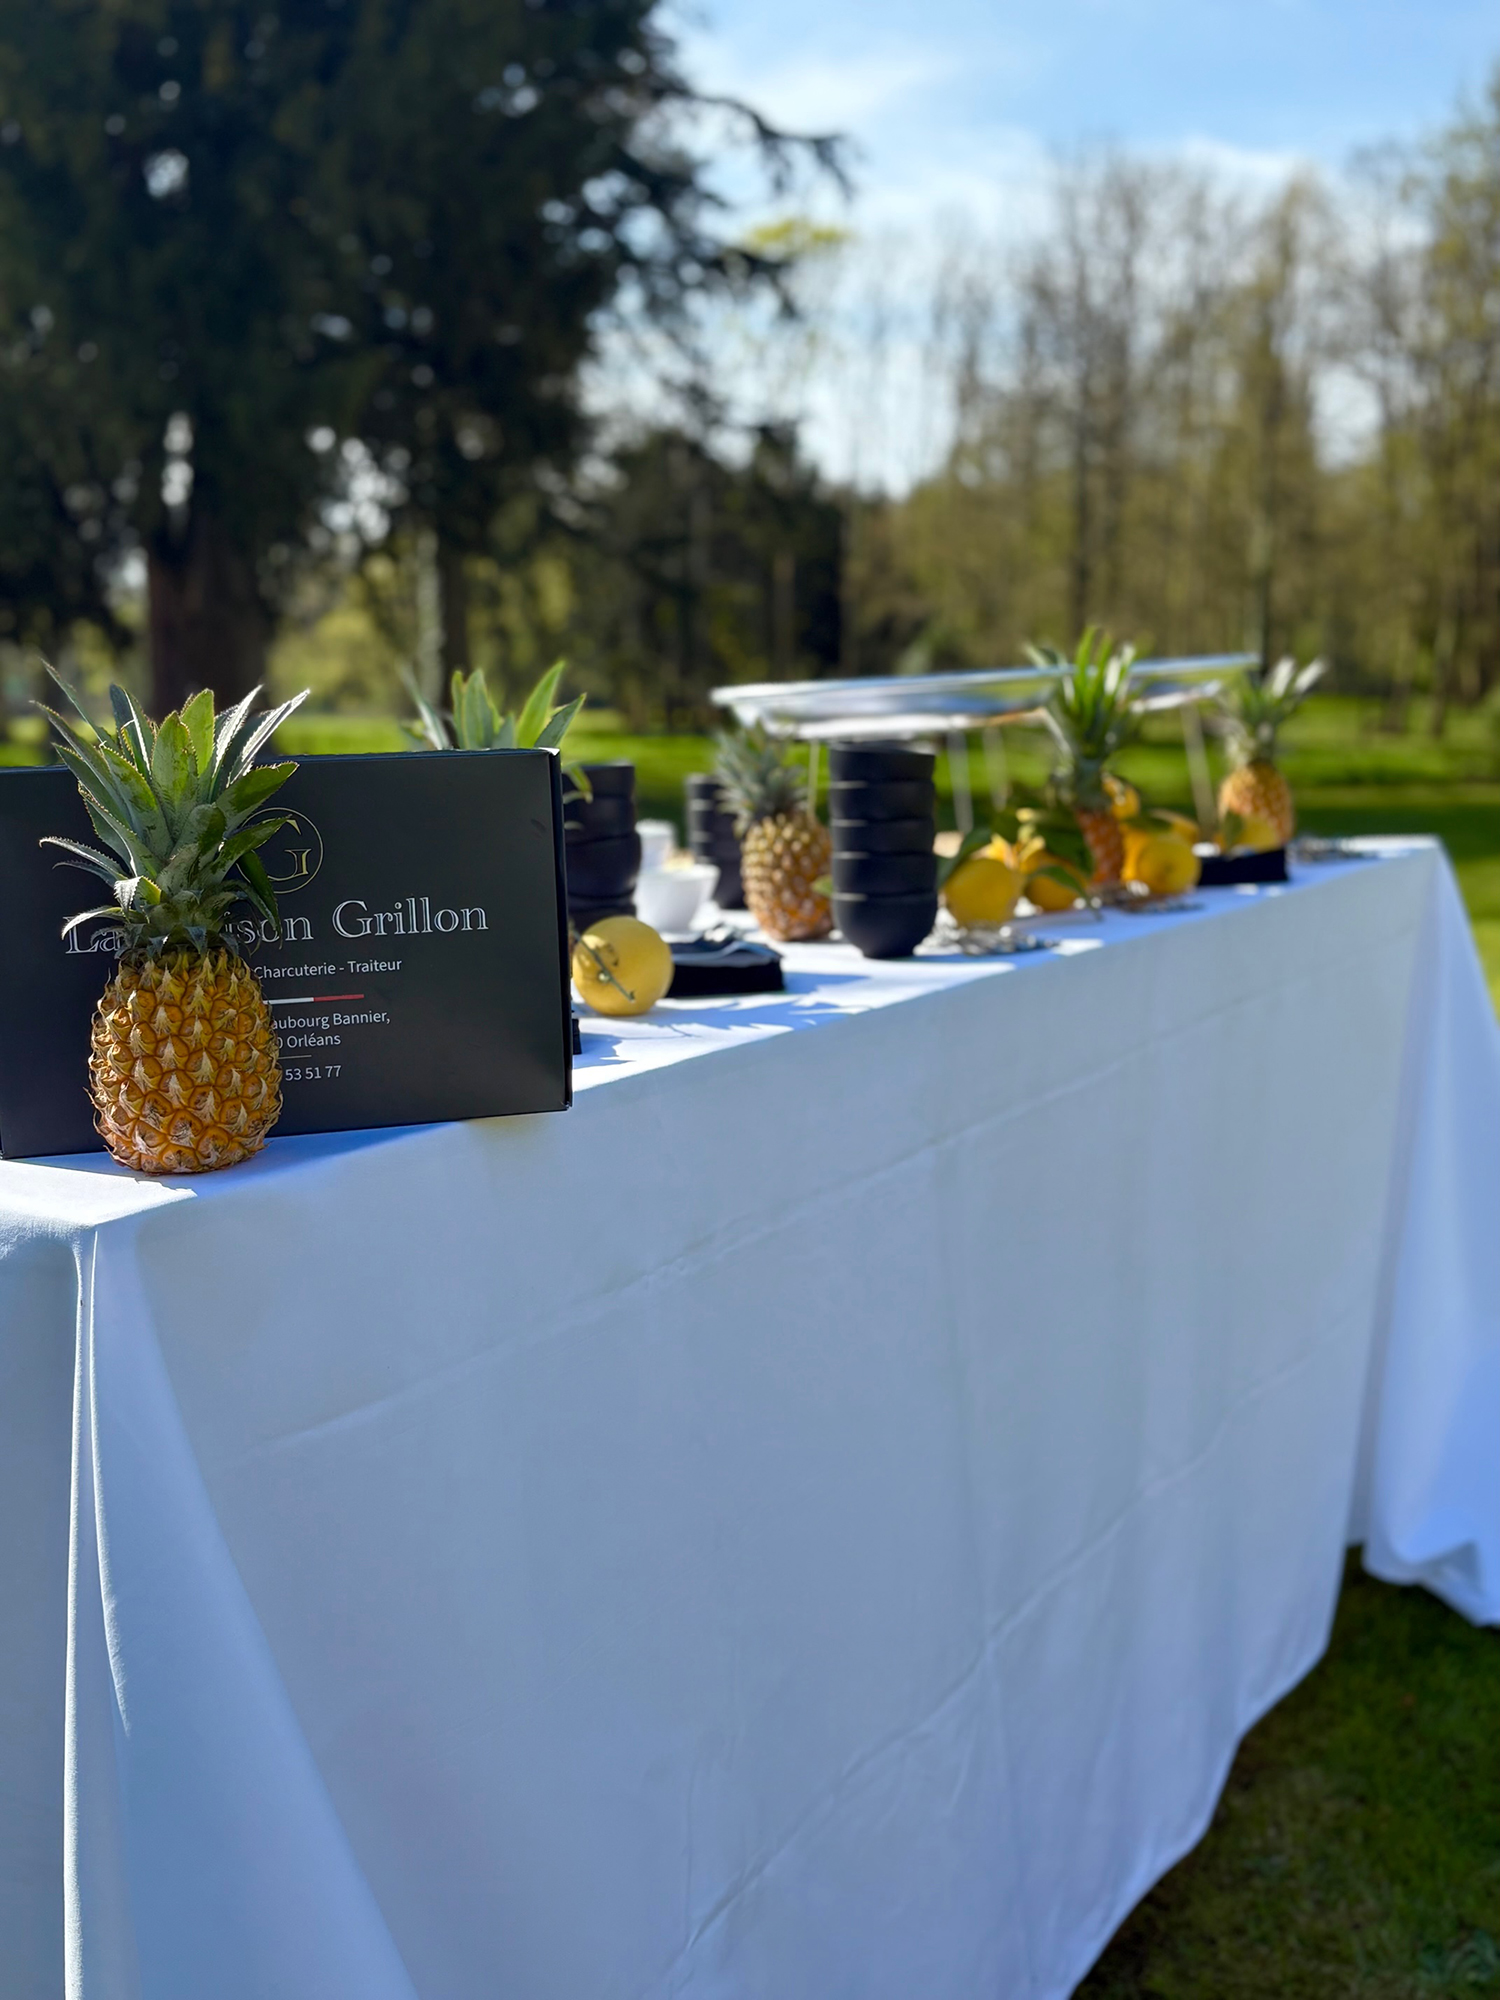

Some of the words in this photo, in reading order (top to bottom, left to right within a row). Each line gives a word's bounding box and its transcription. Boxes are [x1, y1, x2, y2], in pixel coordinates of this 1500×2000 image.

[63, 916, 121, 954] La
[332, 896, 489, 939] Grillon
[254, 962, 336, 979] Charcuterie
[347, 959, 402, 973] Traiteur
[272, 1015, 330, 1030] aubourg
[333, 1010, 390, 1025] Bannier,
[286, 1033, 341, 1049] Orléans
[285, 1068, 302, 1081] 53
[305, 1067, 321, 1080] 51
[325, 1065, 342, 1078] 77
